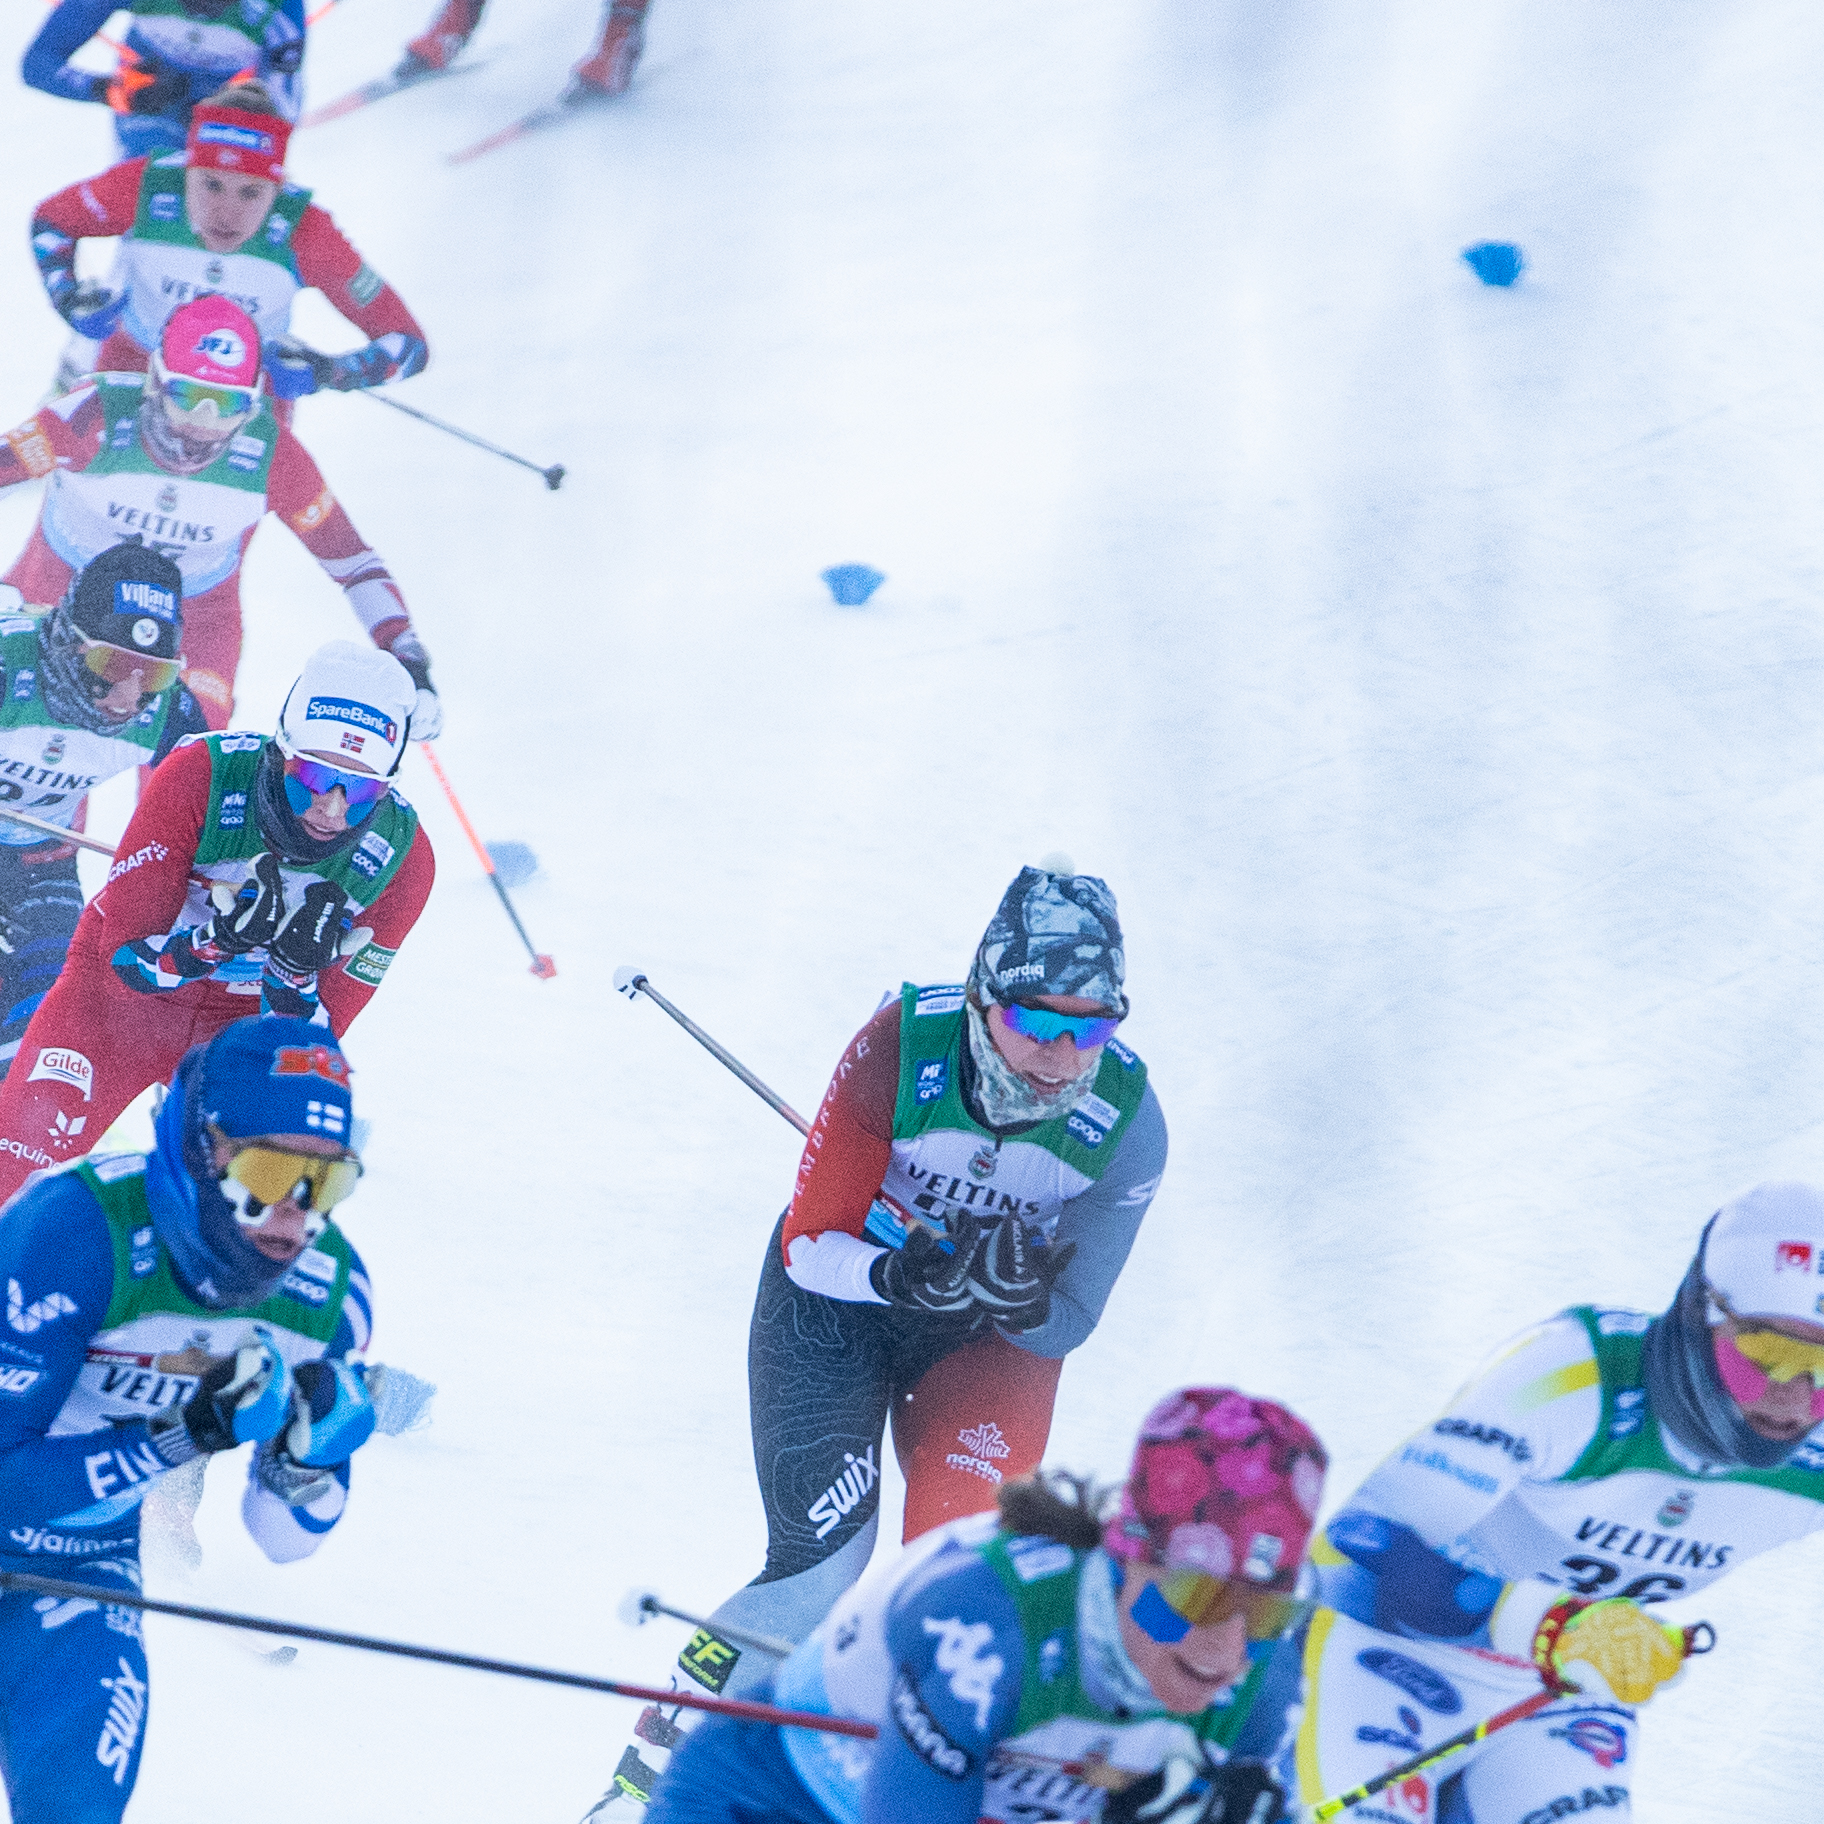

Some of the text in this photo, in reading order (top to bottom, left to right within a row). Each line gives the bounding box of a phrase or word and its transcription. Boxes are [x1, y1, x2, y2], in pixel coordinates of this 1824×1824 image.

[108, 501, 214, 543] VELTINS
[309, 702, 389, 736] SpareBank
[107, 848, 156, 883] CRAFT
[42, 1051, 91, 1079] Gilde
[1068, 1114, 1106, 1145] coop
[909, 1162, 1040, 1217] VELTINS
[1575, 1525, 1734, 1571] VELTINS
